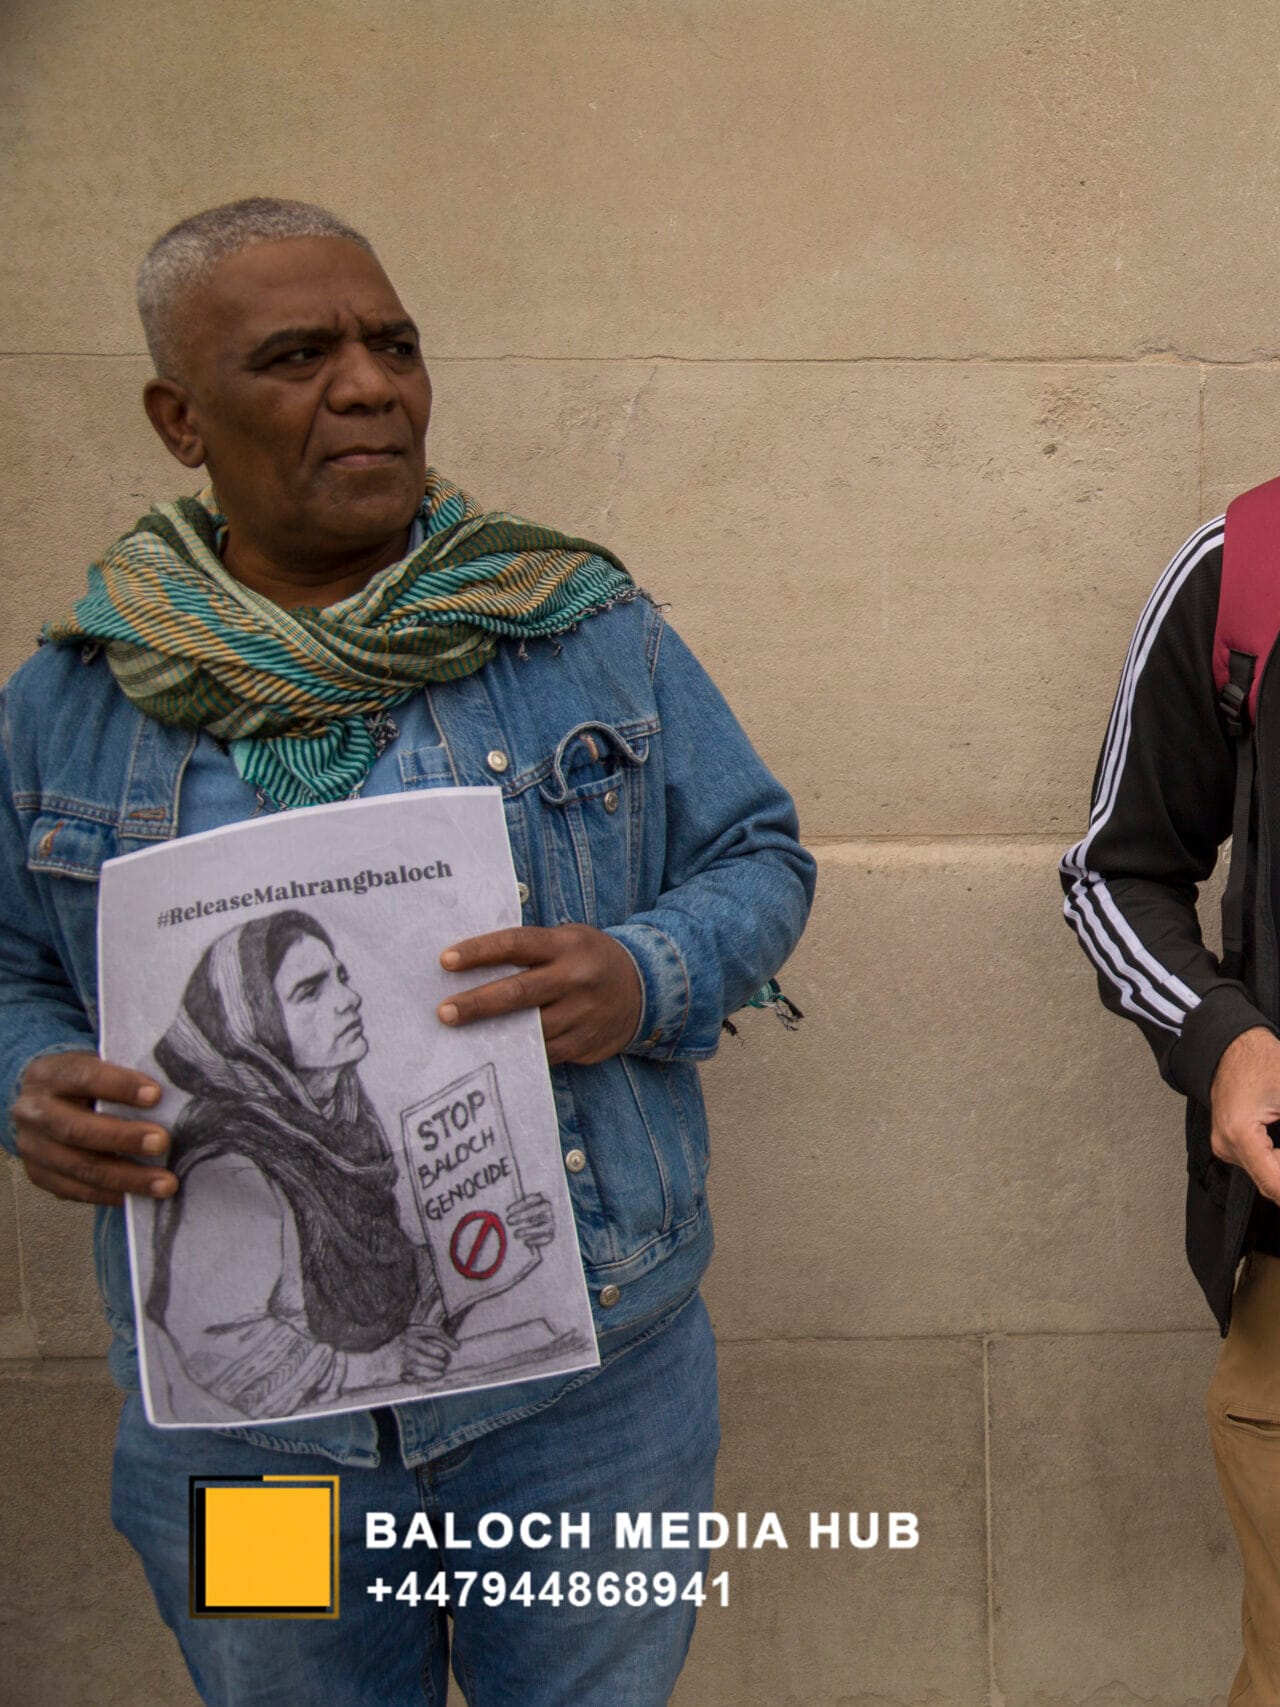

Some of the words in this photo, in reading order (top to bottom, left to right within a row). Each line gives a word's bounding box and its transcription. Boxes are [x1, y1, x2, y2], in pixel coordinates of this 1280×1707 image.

[157, 860, 453, 929] #ReleaseMahrangbaloch
[417, 1089, 487, 1152] STOP
[417, 1126, 496, 1188] BALOCH
[425, 1155, 513, 1221] GENOCIDE
